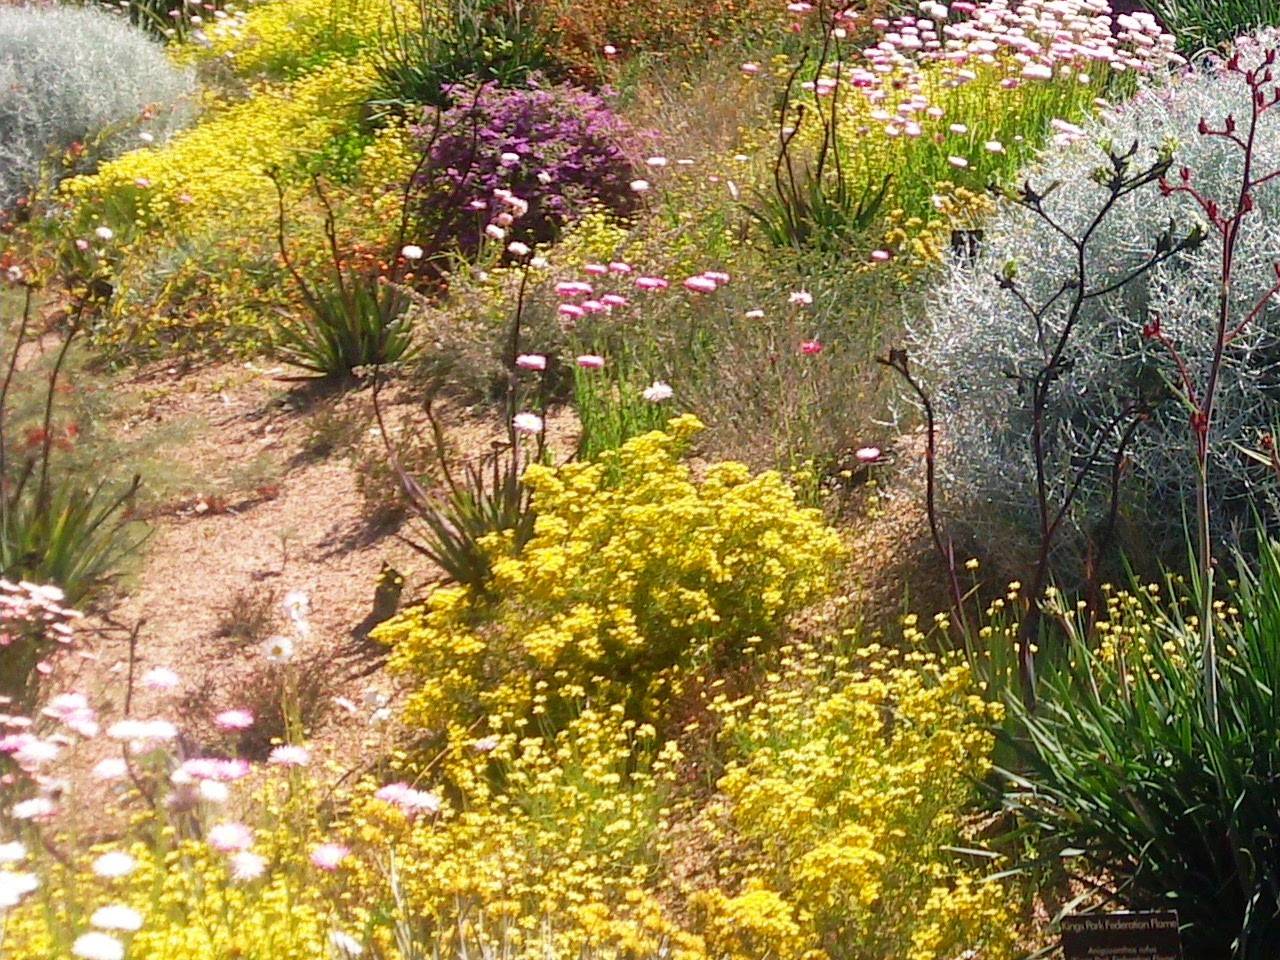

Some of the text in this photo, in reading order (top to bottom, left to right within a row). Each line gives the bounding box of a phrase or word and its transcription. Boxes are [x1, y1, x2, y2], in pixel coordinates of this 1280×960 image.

[1085, 919, 1104, 930] Park
[1105, 919, 1150, 930] Federation
[1150, 918, 1178, 929] Flame
